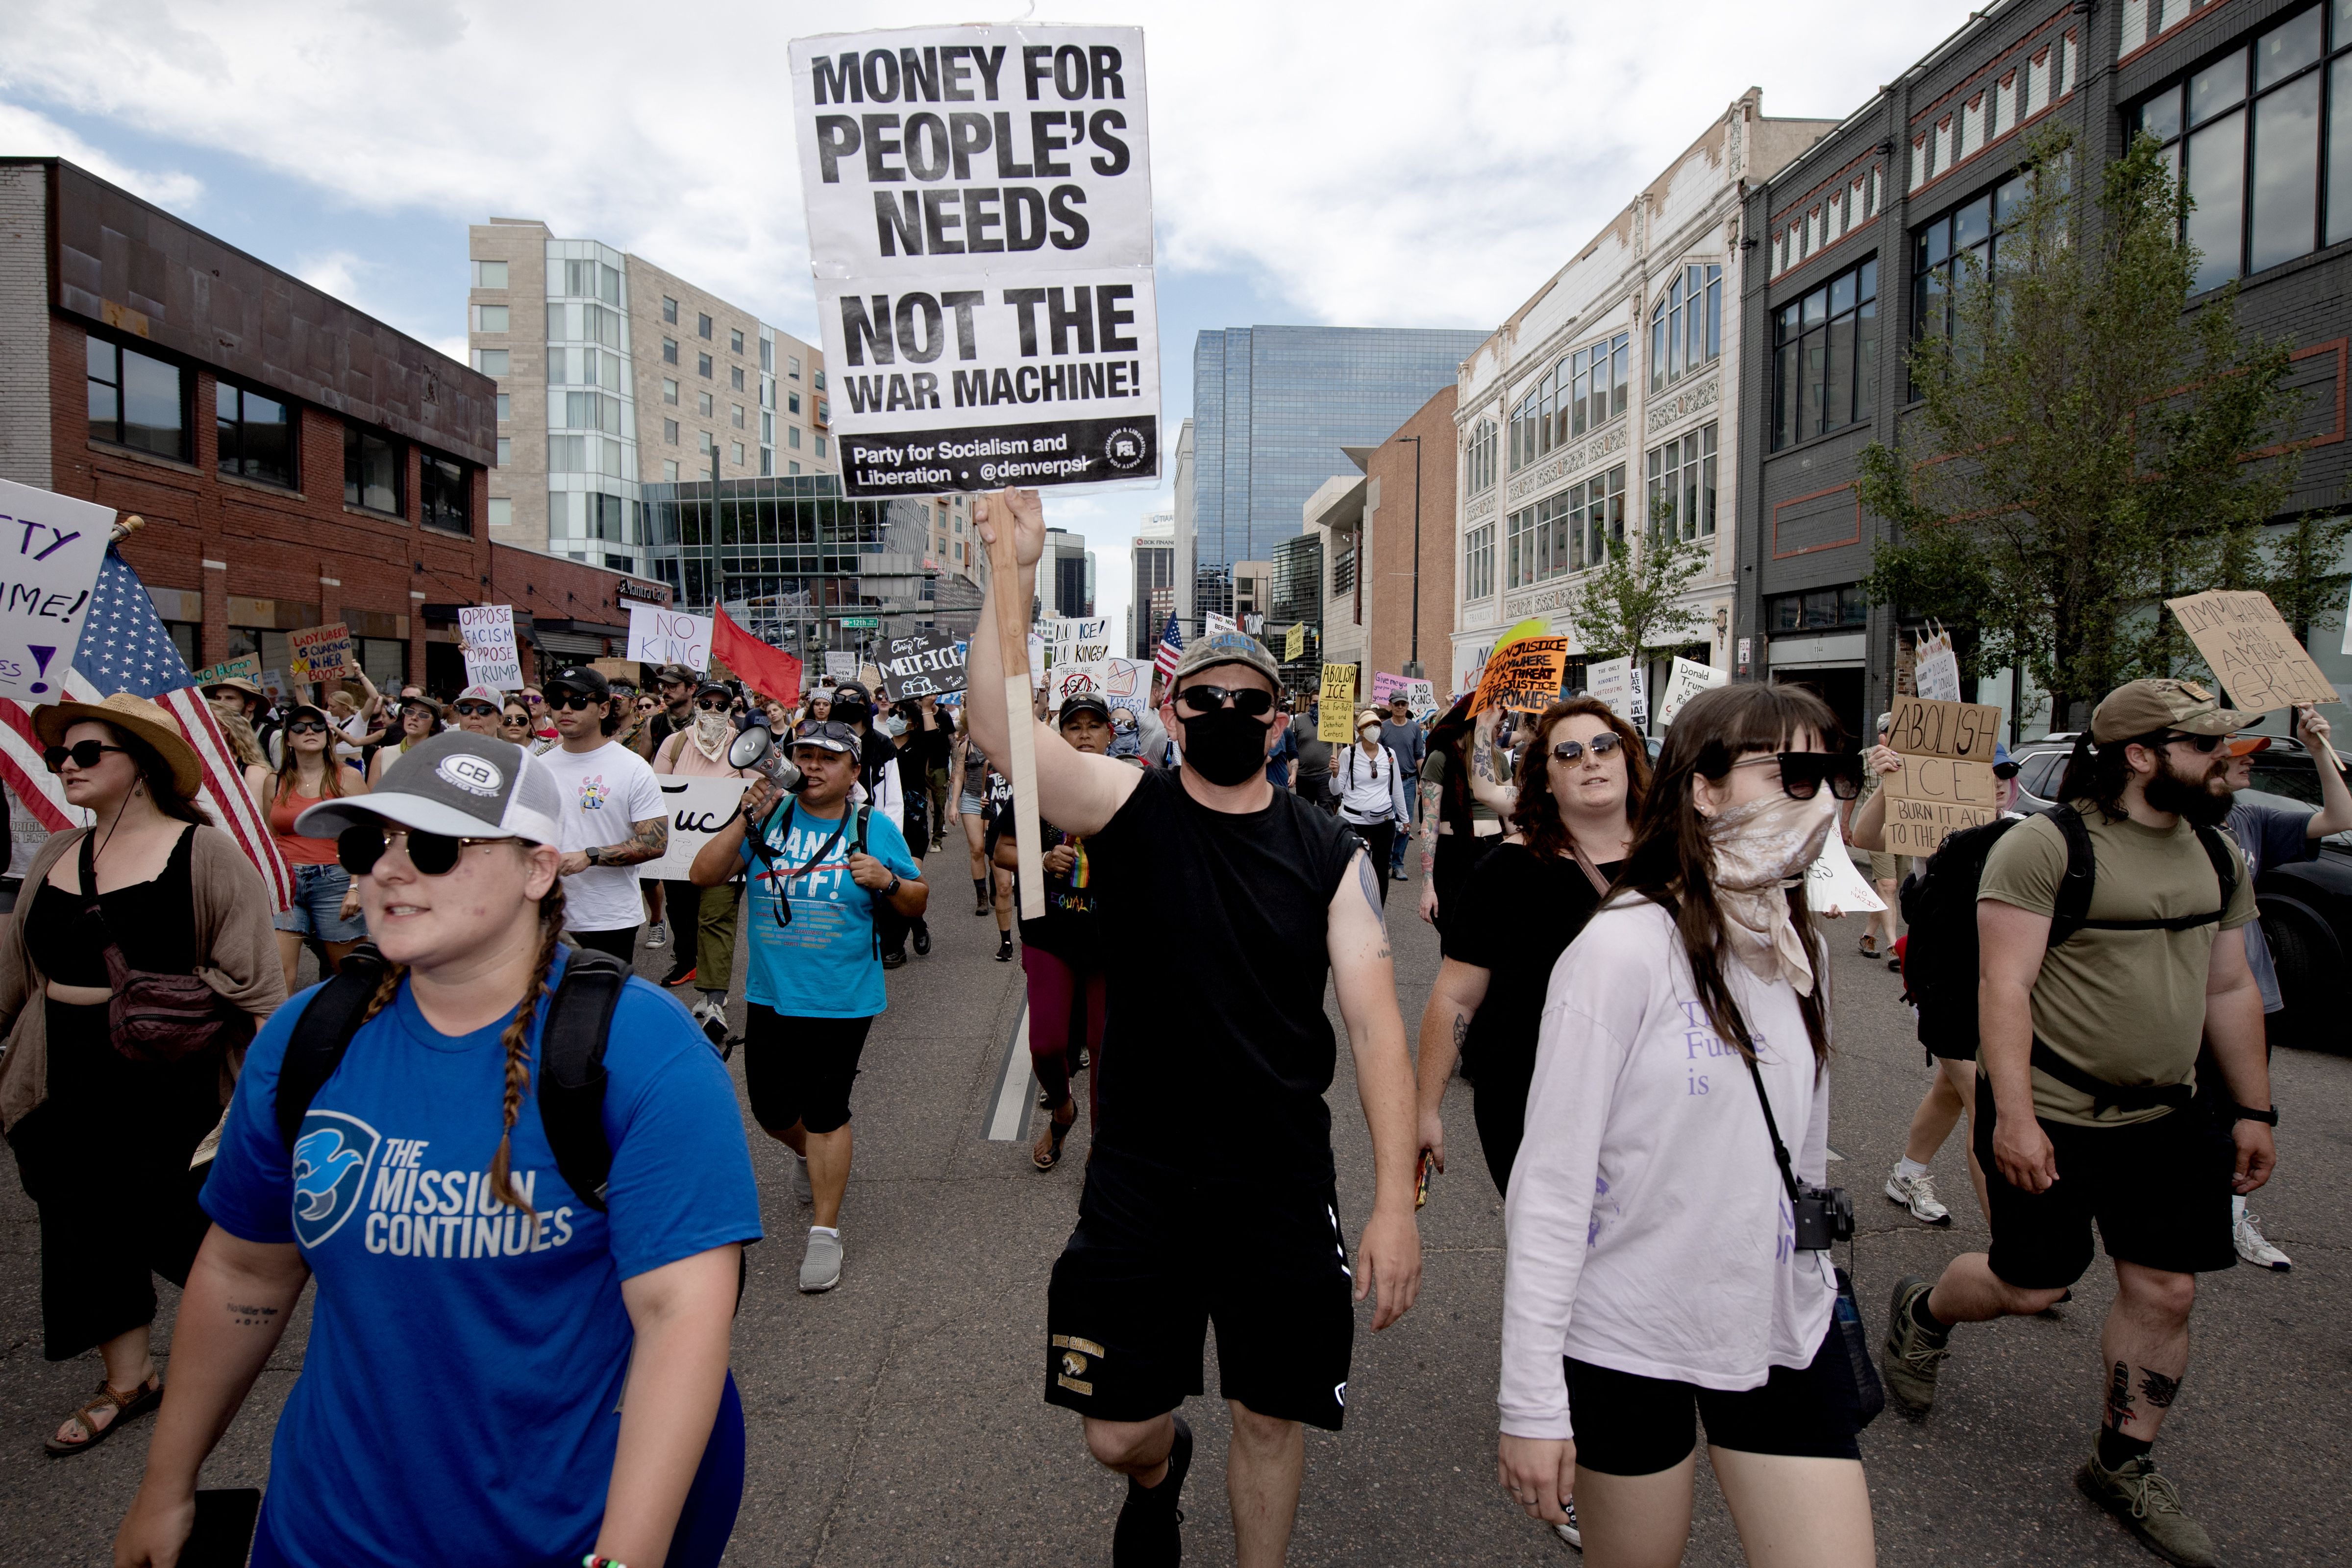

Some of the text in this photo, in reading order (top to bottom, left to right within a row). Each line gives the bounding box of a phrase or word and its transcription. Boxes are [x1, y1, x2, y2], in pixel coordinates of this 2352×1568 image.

[811, 44, 1125, 105] MONEY FOR
[816, 108, 1130, 183] PEOPLE'S
[873, 184, 1089, 256] NEEDS
[840, 284, 1138, 367] NOT THE
[844, 361, 1139, 413] WAR MACHINE!
[854, 434, 1066, 466] Party for Socialism and
[1105, 428, 1122, 459] SOCIALISM
[1128, 427, 1146, 459] LIBERATION
[1116, 441, 1136, 457] PSL
[856, 466, 951, 486] Liberation
[627, 579, 651, 599] Mantra
[462, 608, 510, 626] OPPOSE
[1208, 612, 1223, 622] STAND
[1244, 613, 1264, 635] TRUMP
[1469, 611, 1490, 623] FRANKLIN
[2178, 596, 2281, 634] IMMIGRANTS
[465, 627, 513, 644] FACISM
[657, 613, 694, 639] NO
[1056, 623, 1071, 640] NO
[1290, 625, 1301, 637] THOUGHT
[2228, 626, 2270, 645] MAKE
[293, 632, 318, 647] LADY
[299, 638, 350, 658] IS QUAKING
[891, 635, 929, 655] Closing Time
[1740, 642, 1750, 651] F.D.C.
[309, 653, 343, 669] IN HER
[467, 646, 514, 662] OPPOSE
[642, 637, 701, 667] KING
[1054, 644, 1108, 662] NO KINGS!
[1287, 646, 1301, 657] MATTERED
[2223, 642, 2290, 671] AMERICA
[195, 660, 251, 684] NO Human
[878, 654, 924, 679] MELT
[923, 645, 963, 671] ICE
[1059, 667, 1077, 676] THESE
[1492, 655, 1552, 678] ANYWHERE
[1681, 663, 1709, 681] Donald
[308, 666, 346, 682] BOOTS
[470, 664, 518, 683] TRUMP
[1322, 665, 1356, 684] ABOLISH
[1376, 672, 1389, 684] Give
[1498, 672, 1509, 683] A
[1510, 666, 1557, 680] THREAT
[1598, 675, 1620, 685] MINORITY
[1938, 674, 1954, 690] DONALD
[1060, 678, 1100, 699] FASCIST
[1415, 684, 1427, 693] NO
[1504, 680, 1558, 691] JUSTICE
[1594, 686, 1622, 696] DESTROYING
[2232, 661, 2327, 707] GREAT
[1319, 701, 1352, 712] End For-Profit
[1474, 689, 1559, 714] EVERYWHERE
[1322, 712, 1335, 720] Prisons
[1888, 704, 1998, 756] ABOLISH
[457, 761, 489, 783] CB
[1902, 758, 1976, 801] ICE
[1898, 800, 1932, 820] BURN
[1939, 806, 1954, 824] IT
[766, 825, 850, 864] HAND
[1889, 823, 1906, 844] TO
[1911, 825, 1936, 848] THE
[642, 865, 659, 876] NO
[765, 859, 843, 900] OFF!
[1851, 891, 1877, 908] NAZIS
[1856, 887, 1867, 896] NO
[1688, 1069, 1709, 1096] is
[381, 1138, 429, 1168] THE
[369, 1167, 536, 1216] MISSION
[365, 1206, 573, 1259] CONTINUES
[1069, 1336, 1104, 1359] CANYON
[1058, 1372, 1092, 1396] LACROSSE
